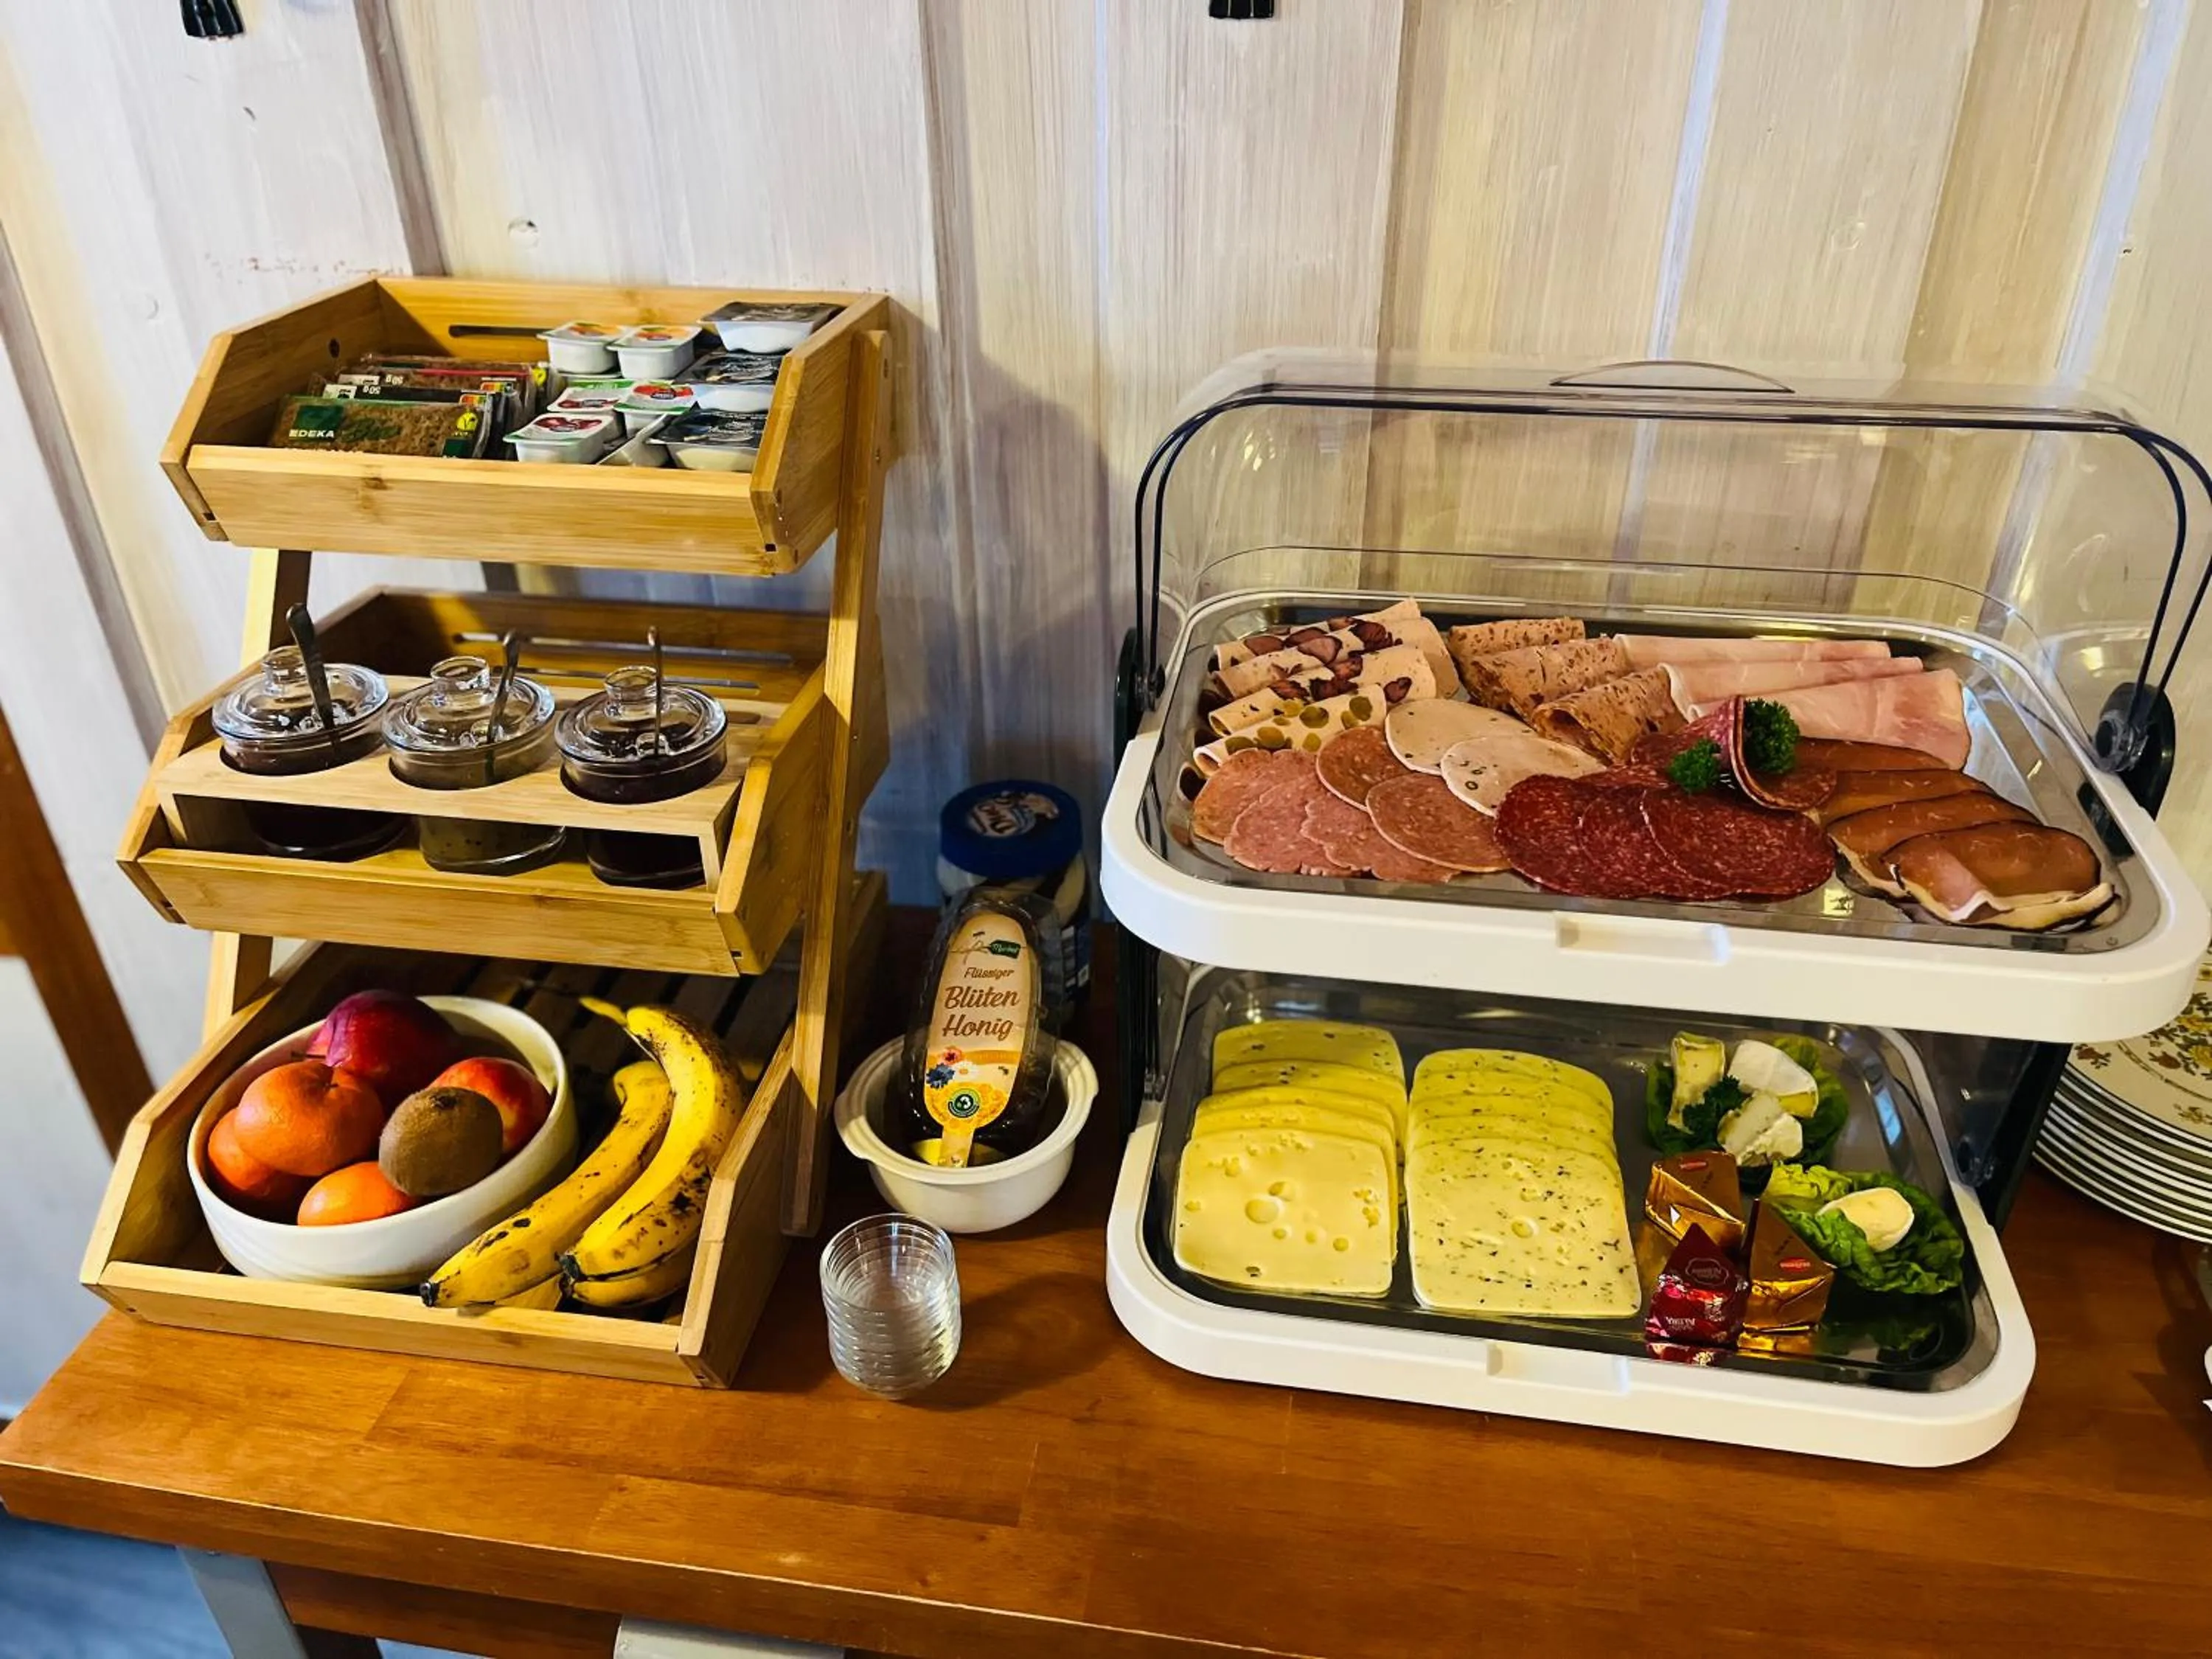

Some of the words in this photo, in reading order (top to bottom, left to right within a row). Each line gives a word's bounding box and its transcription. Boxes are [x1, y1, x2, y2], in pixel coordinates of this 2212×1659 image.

[289, 429, 334, 437] EDEKA
[944, 985, 1020, 1009] Blüten
[942, 1014, 1014, 1041] Honig
